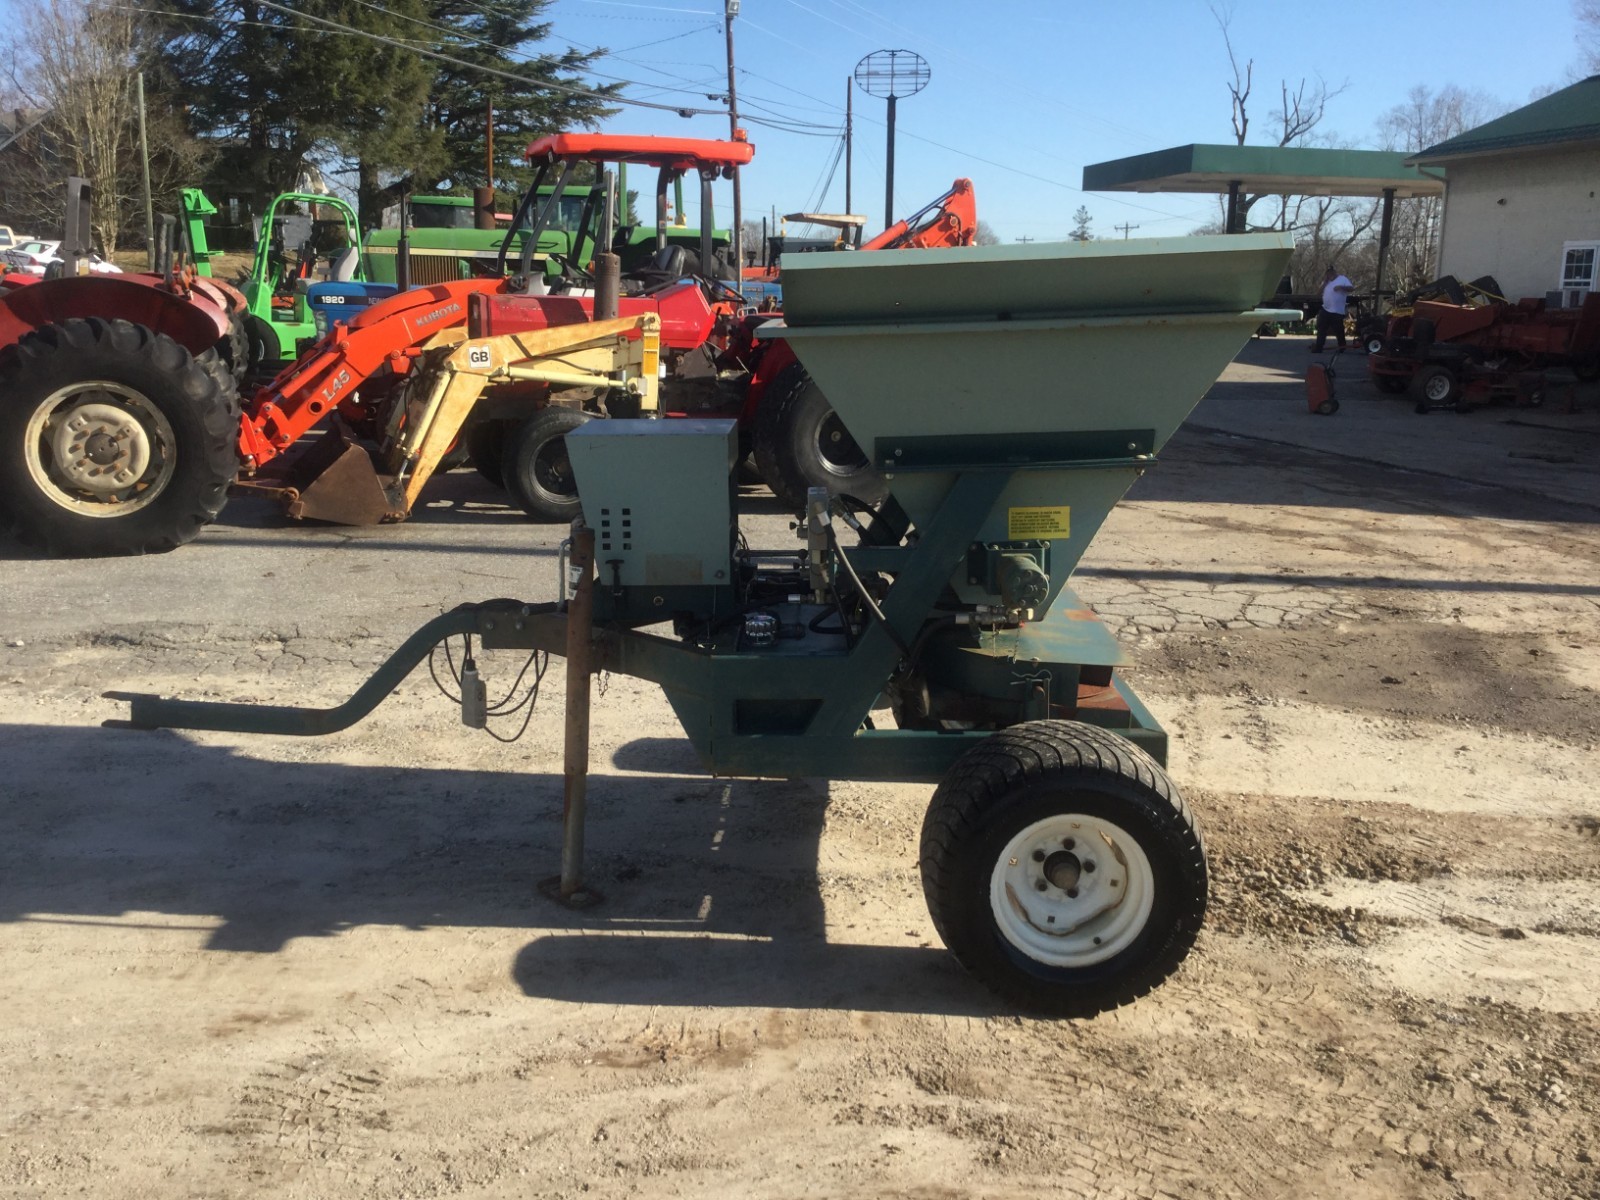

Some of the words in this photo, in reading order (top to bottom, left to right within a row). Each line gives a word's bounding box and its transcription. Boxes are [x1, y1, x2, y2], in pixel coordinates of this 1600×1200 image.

[321, 295, 345, 304] 1920
[415, 303, 462, 327] KUBOTA
[470, 351, 489, 363] GB
[321, 369, 350, 402] L45
